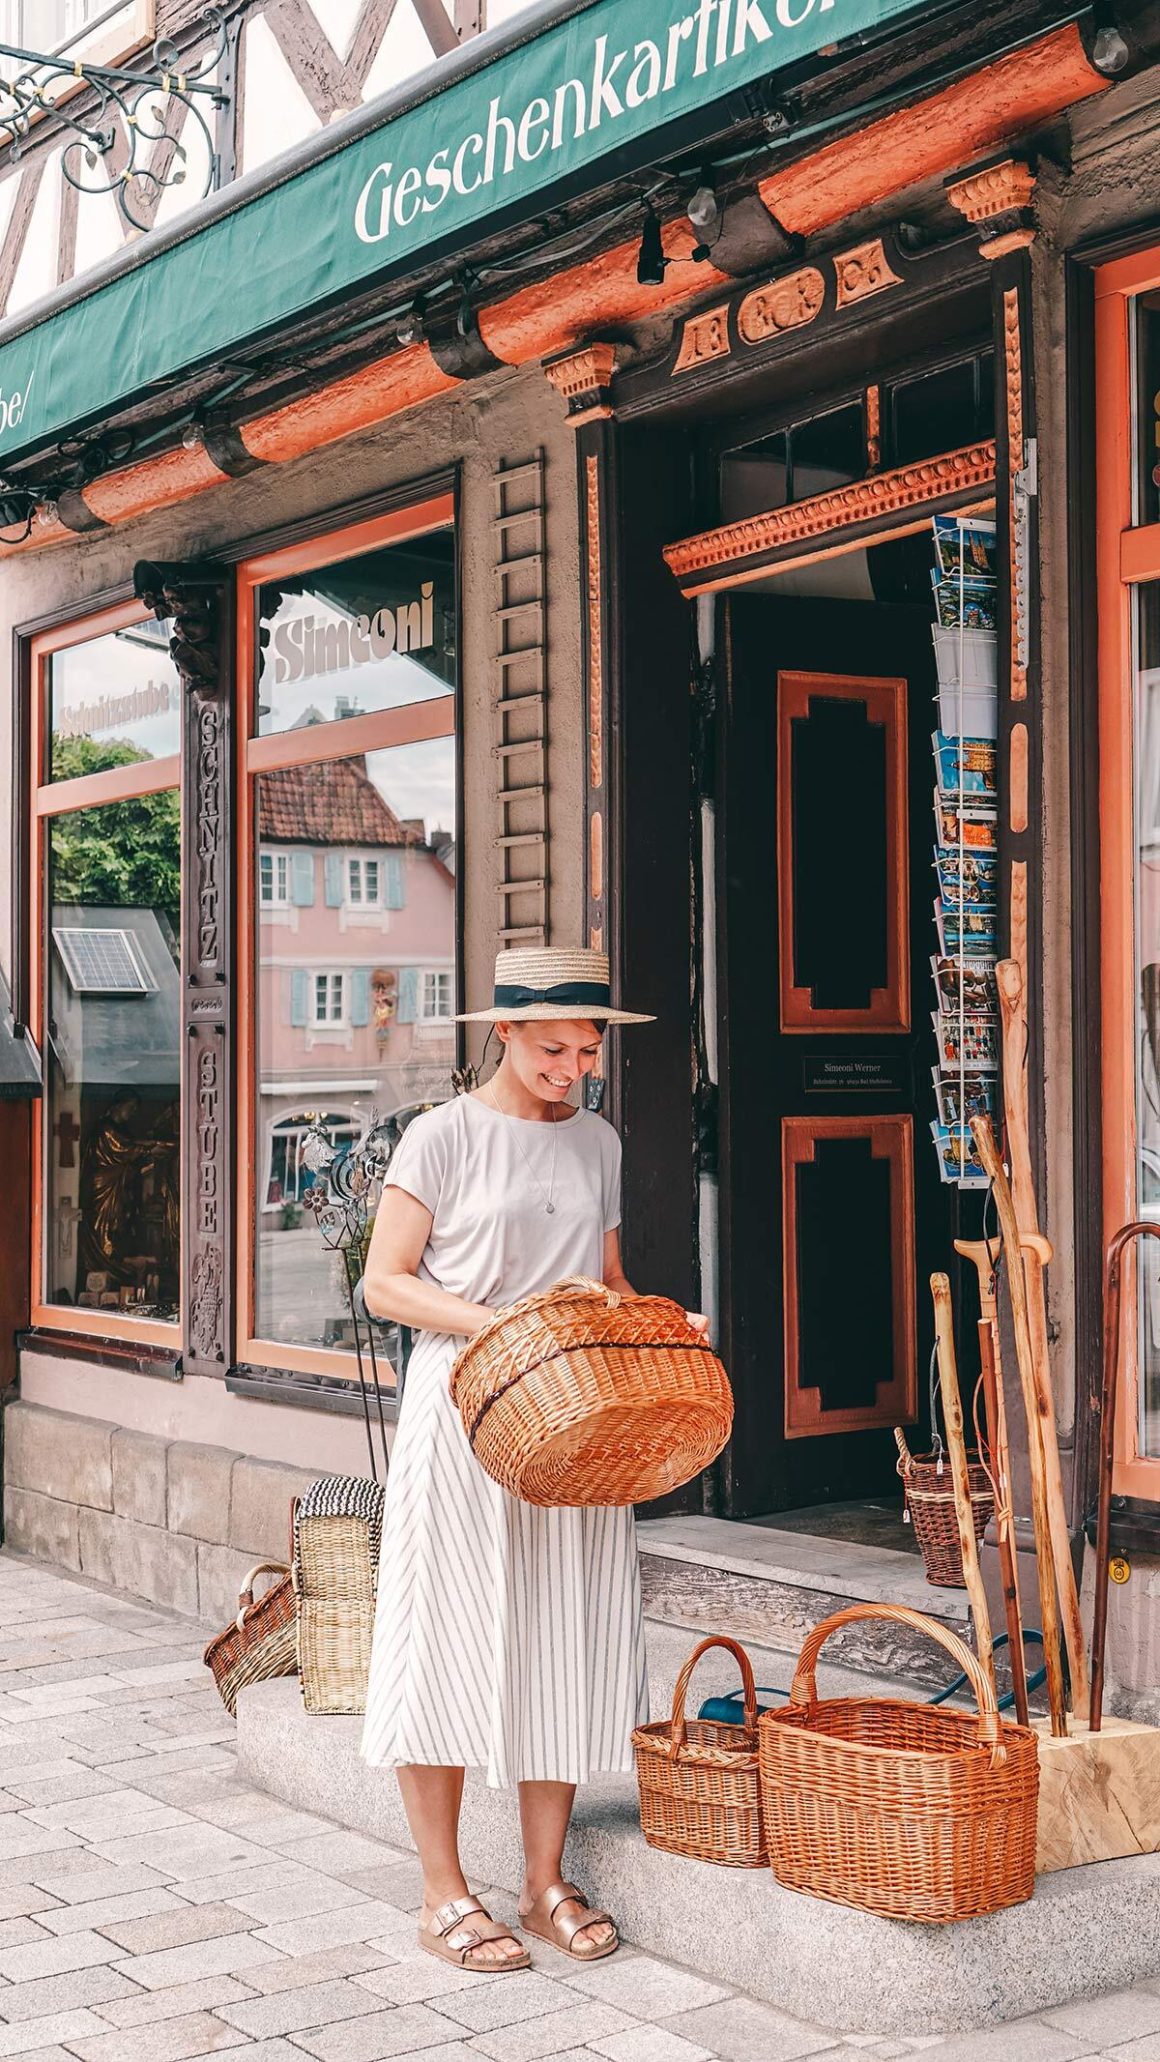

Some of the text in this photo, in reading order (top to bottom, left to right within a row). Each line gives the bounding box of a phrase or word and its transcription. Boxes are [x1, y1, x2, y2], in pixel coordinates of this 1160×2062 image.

[354, 0, 835, 243] Geschenkartik
[275, 581, 434, 684] Simeoni
[200, 709, 219, 963] SCHNITZ
[199, 1051, 217, 1233] STUBE
[855, 1063, 881, 1072] Werner
